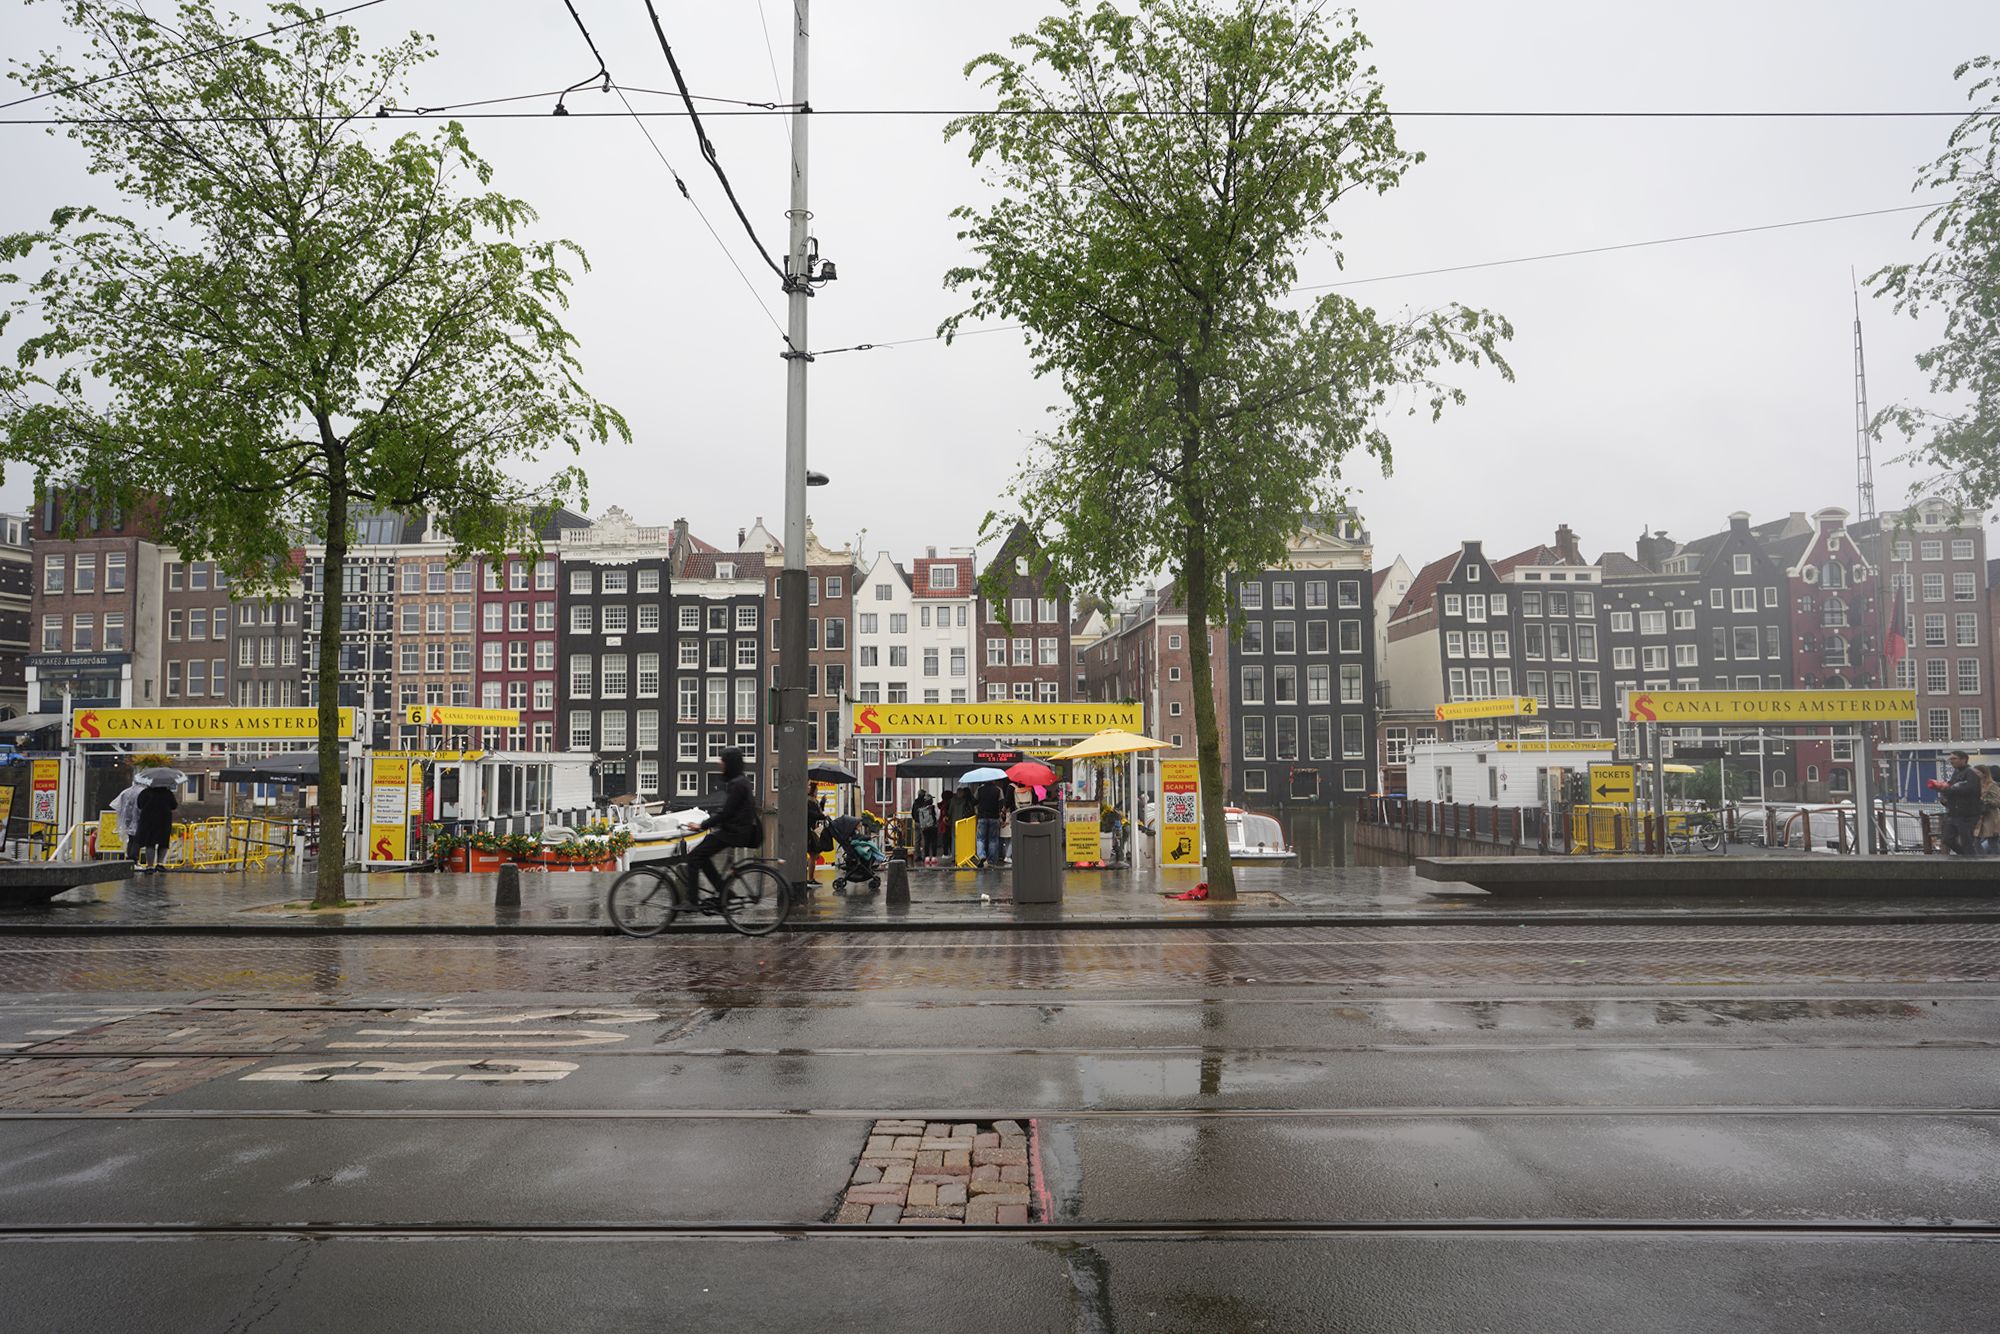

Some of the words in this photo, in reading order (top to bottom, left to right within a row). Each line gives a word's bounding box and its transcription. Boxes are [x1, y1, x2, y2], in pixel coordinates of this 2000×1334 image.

[64, 656, 108, 665] Amsterdam
[1481, 704, 1515, 713] AMSTERDAM
[1523, 702, 1533, 714] 4
[1663, 701, 1724, 713] CANAL
[1731, 701, 1791, 712] TOURS
[1798, 700, 1915, 712] AMSTERDAM
[107, 718, 165, 730] CANAL
[171, 717, 229, 729] TOURS
[235, 716, 346, 729] AMSTERD
[412, 711, 422, 723] 6
[888, 713, 948, 726] CANAL
[954, 713, 1014, 726] TOURS
[1020, 713, 1135, 726] AMSTERDAM
[1594, 771, 1631, 779] TICKETS
